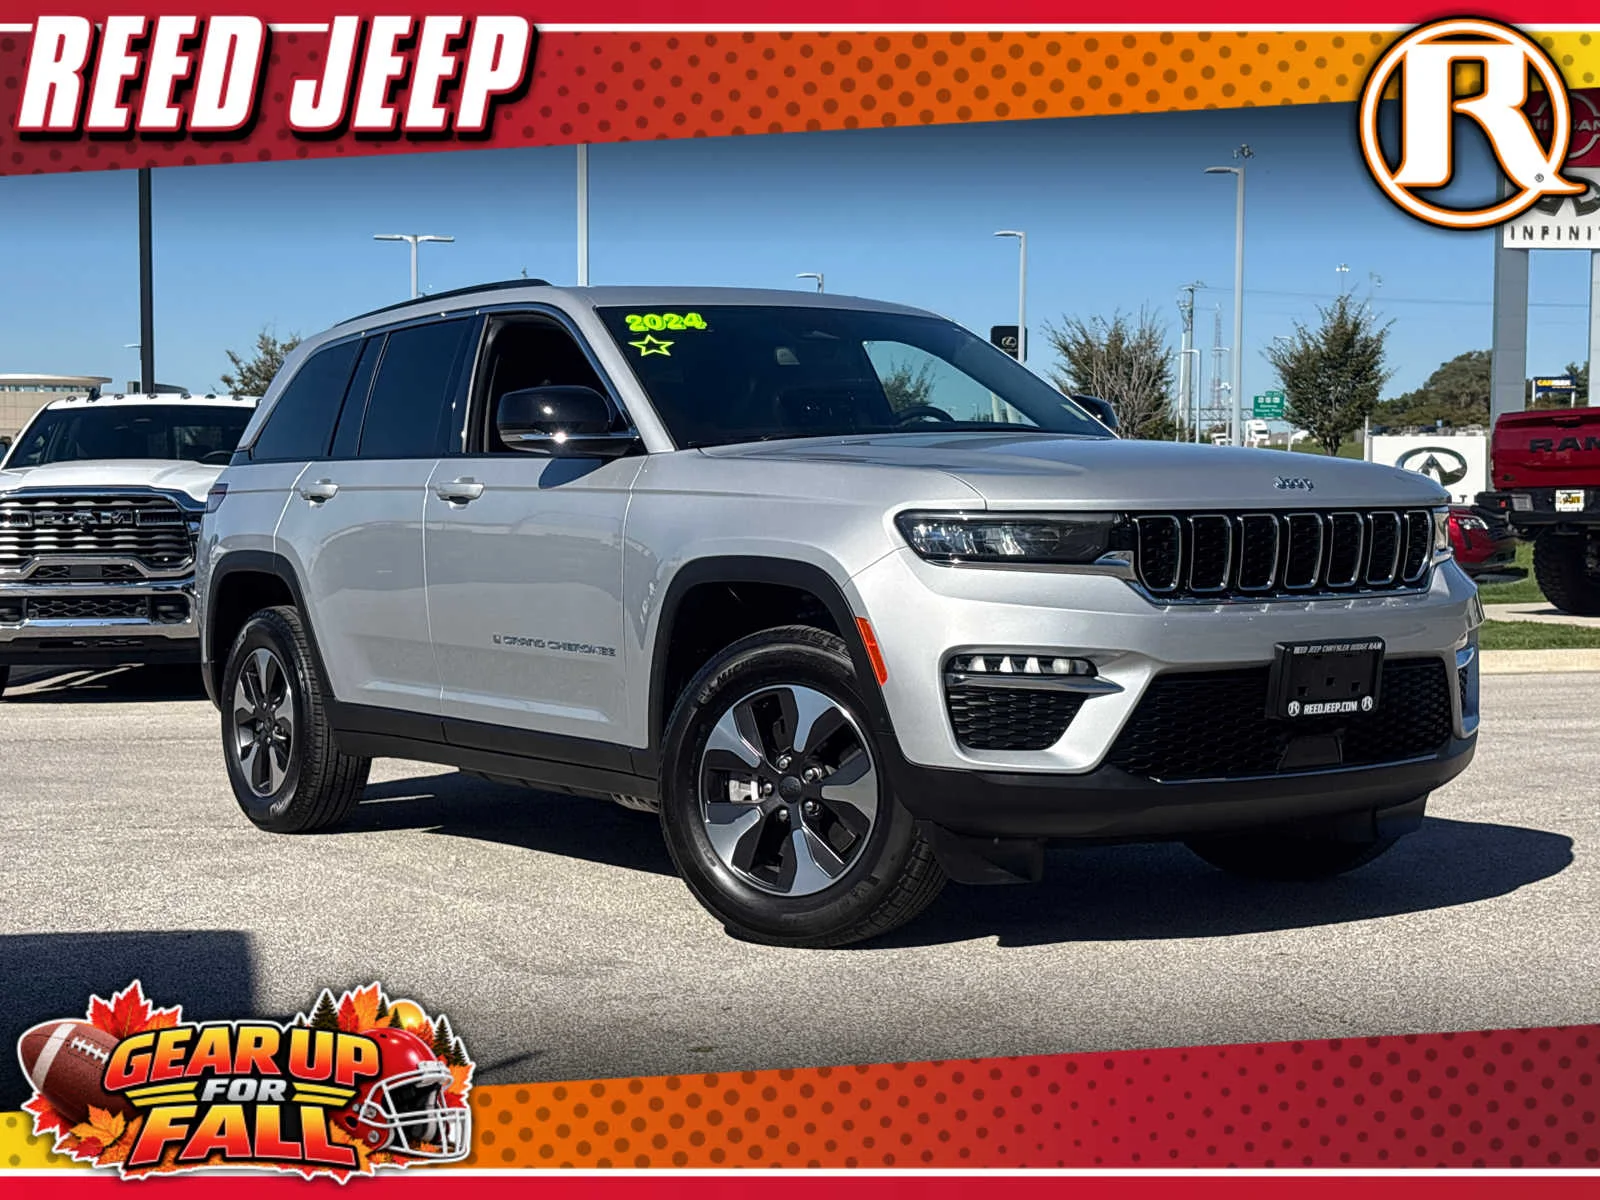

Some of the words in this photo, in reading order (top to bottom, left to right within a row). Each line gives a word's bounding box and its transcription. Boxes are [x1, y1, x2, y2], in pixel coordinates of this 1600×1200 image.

[1510, 225, 1600, 241] INFINI
[624, 312, 708, 332] 2024
[1272, 475, 1314, 491] Jeep
[32, 508, 136, 527] RAM
[503, 635, 545, 649] GRAND
[1368, 642, 1382, 650] RAM
[1303, 701, 1358, 715] REEDJEEP.COM
